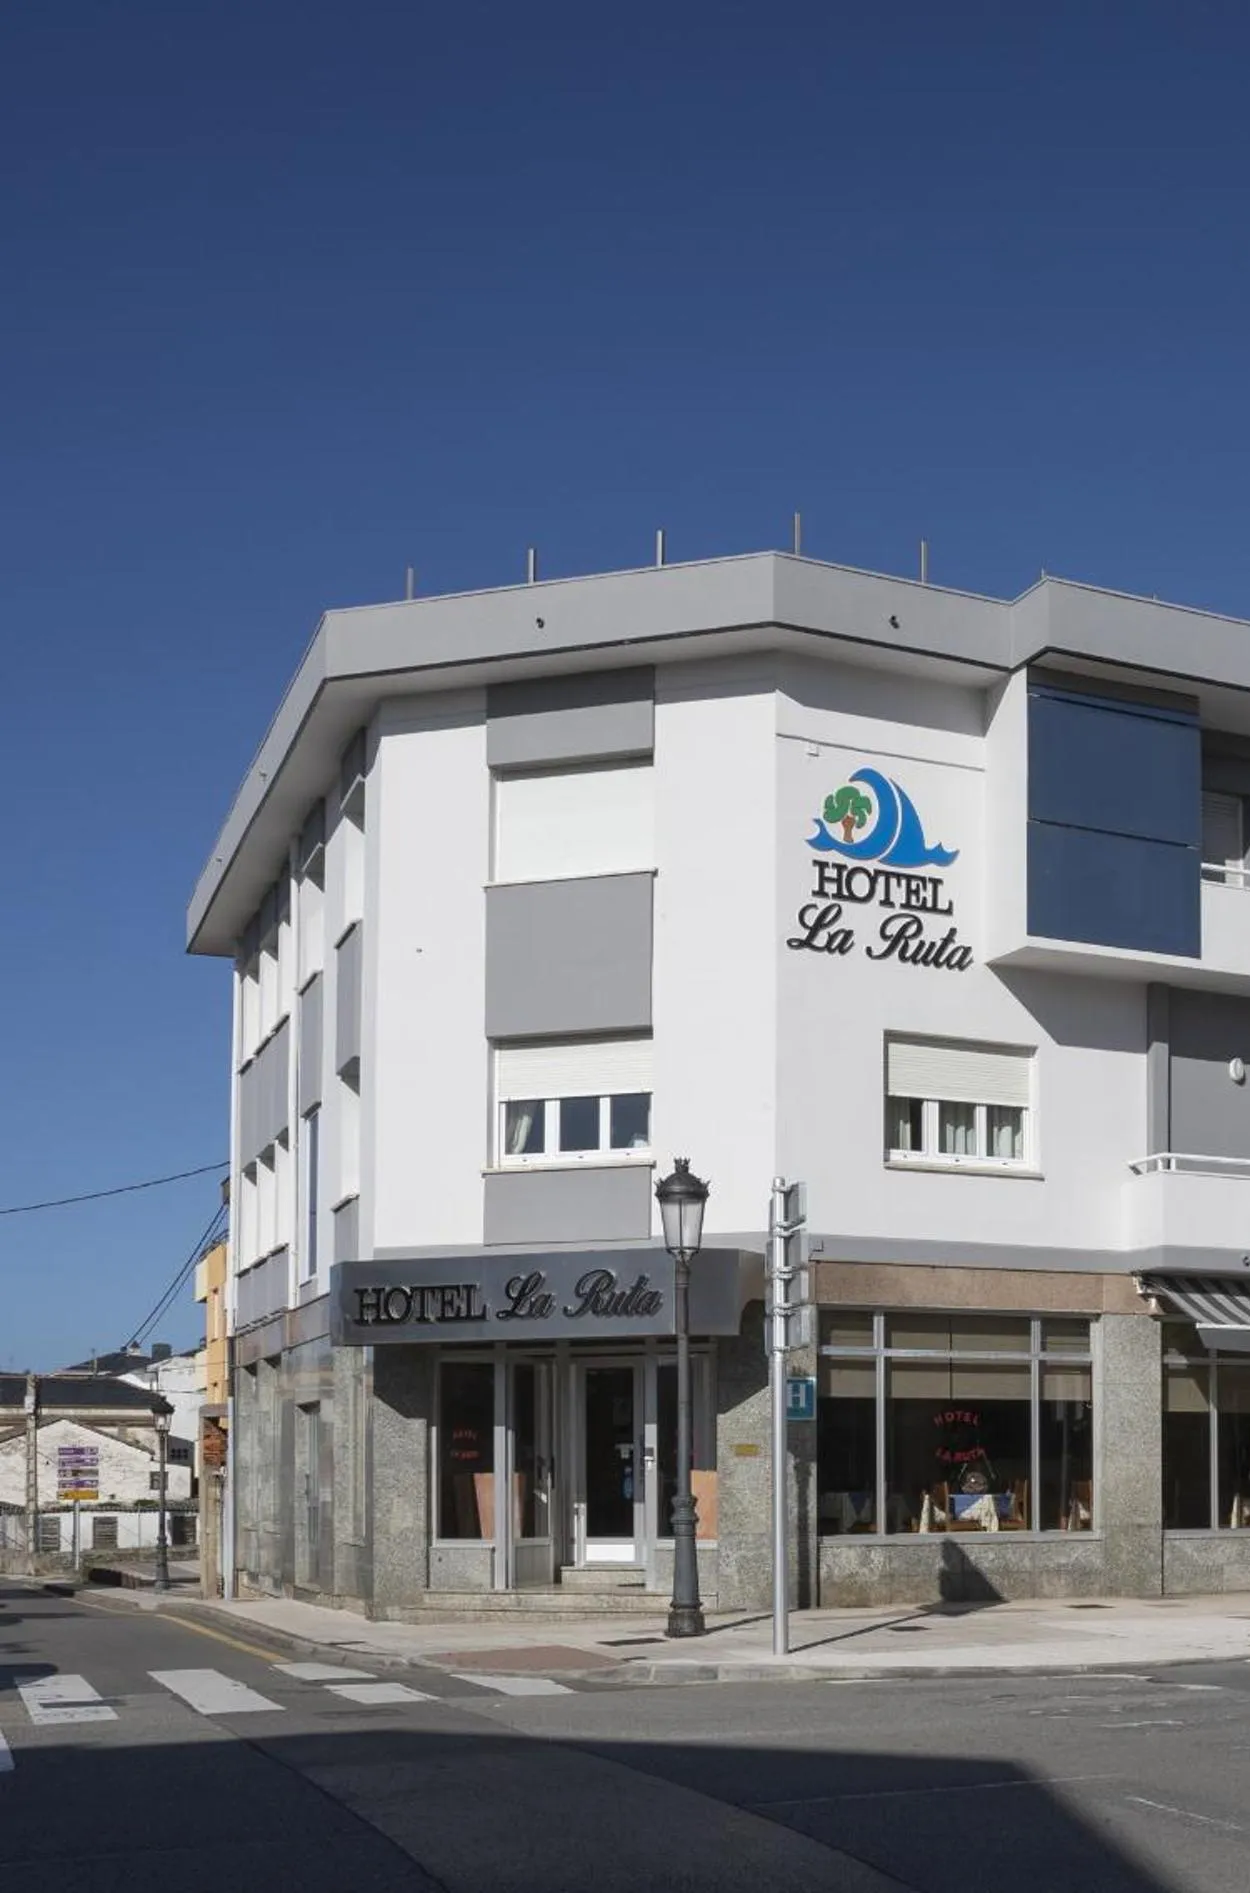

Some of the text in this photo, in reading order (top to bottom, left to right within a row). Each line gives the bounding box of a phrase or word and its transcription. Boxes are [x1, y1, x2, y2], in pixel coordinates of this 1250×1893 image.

[812, 859, 953, 916] HOTEL
[786, 903, 974, 972] La Ruta
[353, 1268, 664, 1325] HOTEL La Ruta
[786, 1383, 806, 1408] H
[933, 1410, 979, 1427] HOTEL
